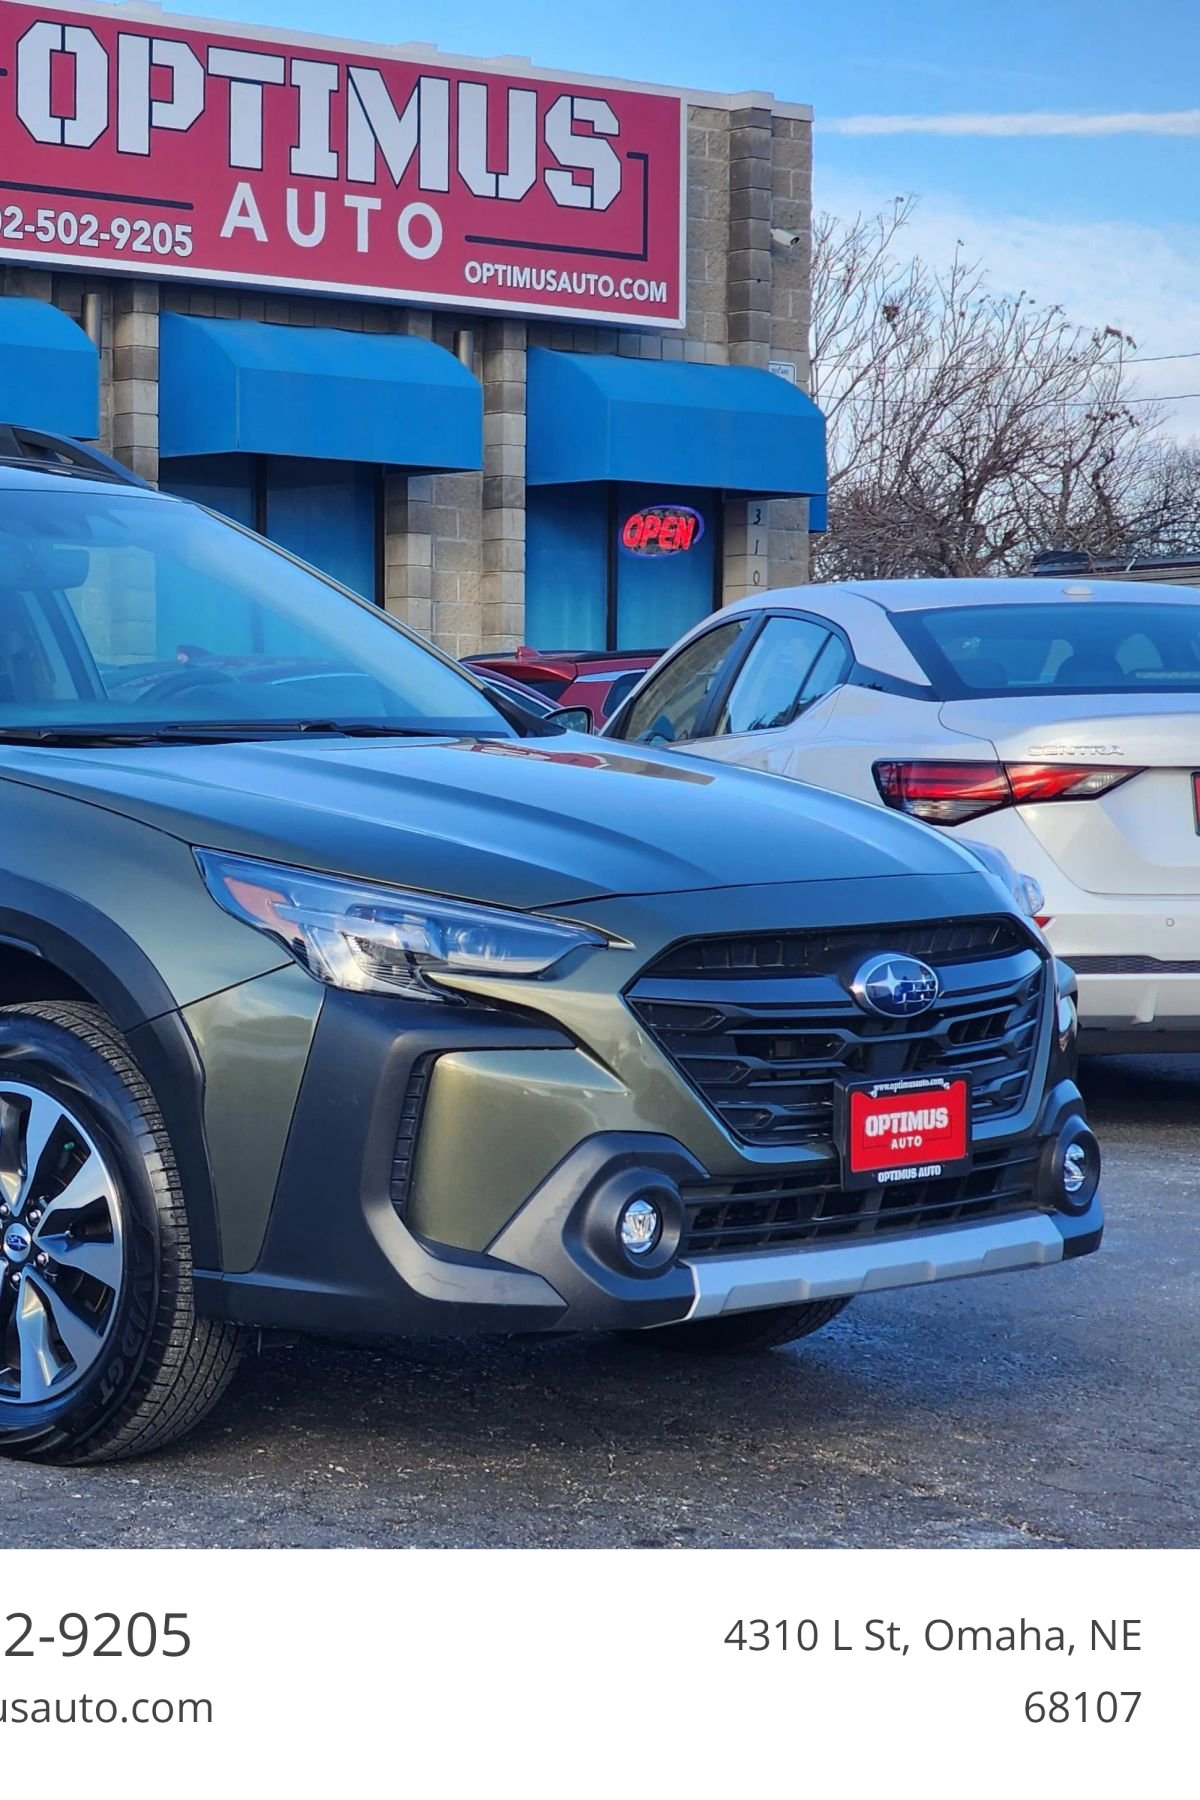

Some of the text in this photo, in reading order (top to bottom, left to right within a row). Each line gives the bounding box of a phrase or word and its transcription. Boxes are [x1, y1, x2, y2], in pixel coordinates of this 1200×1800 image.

[17, 20, 622, 211] OPTIMUS
[220, 182, 443, 260] AUTO
[464, 261, 667, 304] OPTIMUSAUTO.COM
[622, 514, 696, 550] OPEN
[1028, 745, 1125, 756] SENTRA
[873, 1078, 944, 1092] www.optimusauto.com
[865, 1107, 948, 1137] OPTIMUS
[891, 1136, 922, 1149] AUTO
[878, 1165, 941, 1183] OPTIMUS AUTO
